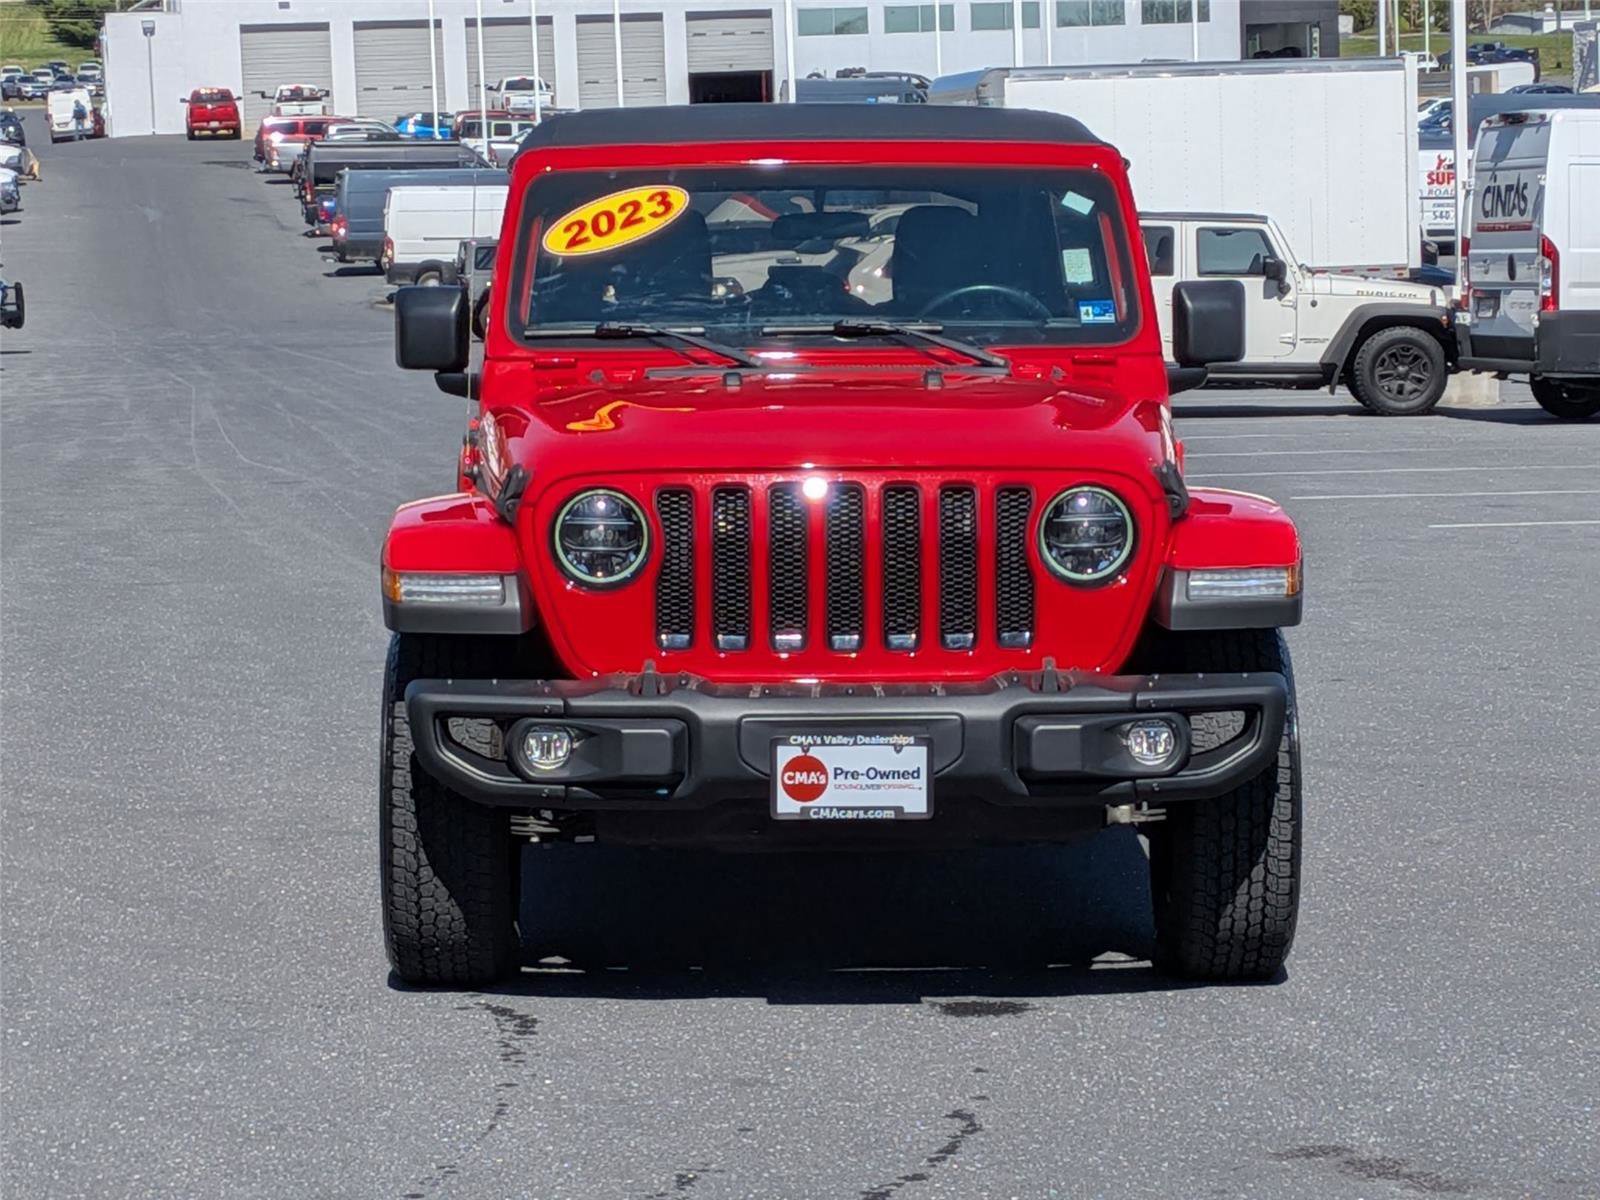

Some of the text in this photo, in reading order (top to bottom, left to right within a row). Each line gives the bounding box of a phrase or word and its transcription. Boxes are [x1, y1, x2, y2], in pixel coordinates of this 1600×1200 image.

[1481, 172, 1529, 219] CINTAS
[562, 190, 675, 250] 2023
[789, 734, 916, 746] CMA's Valley Dealerships
[783, 771, 827, 785] CMA's
[833, 766, 921, 781] Pre-Owned
[809, 807, 896, 819] CMAcars.com
